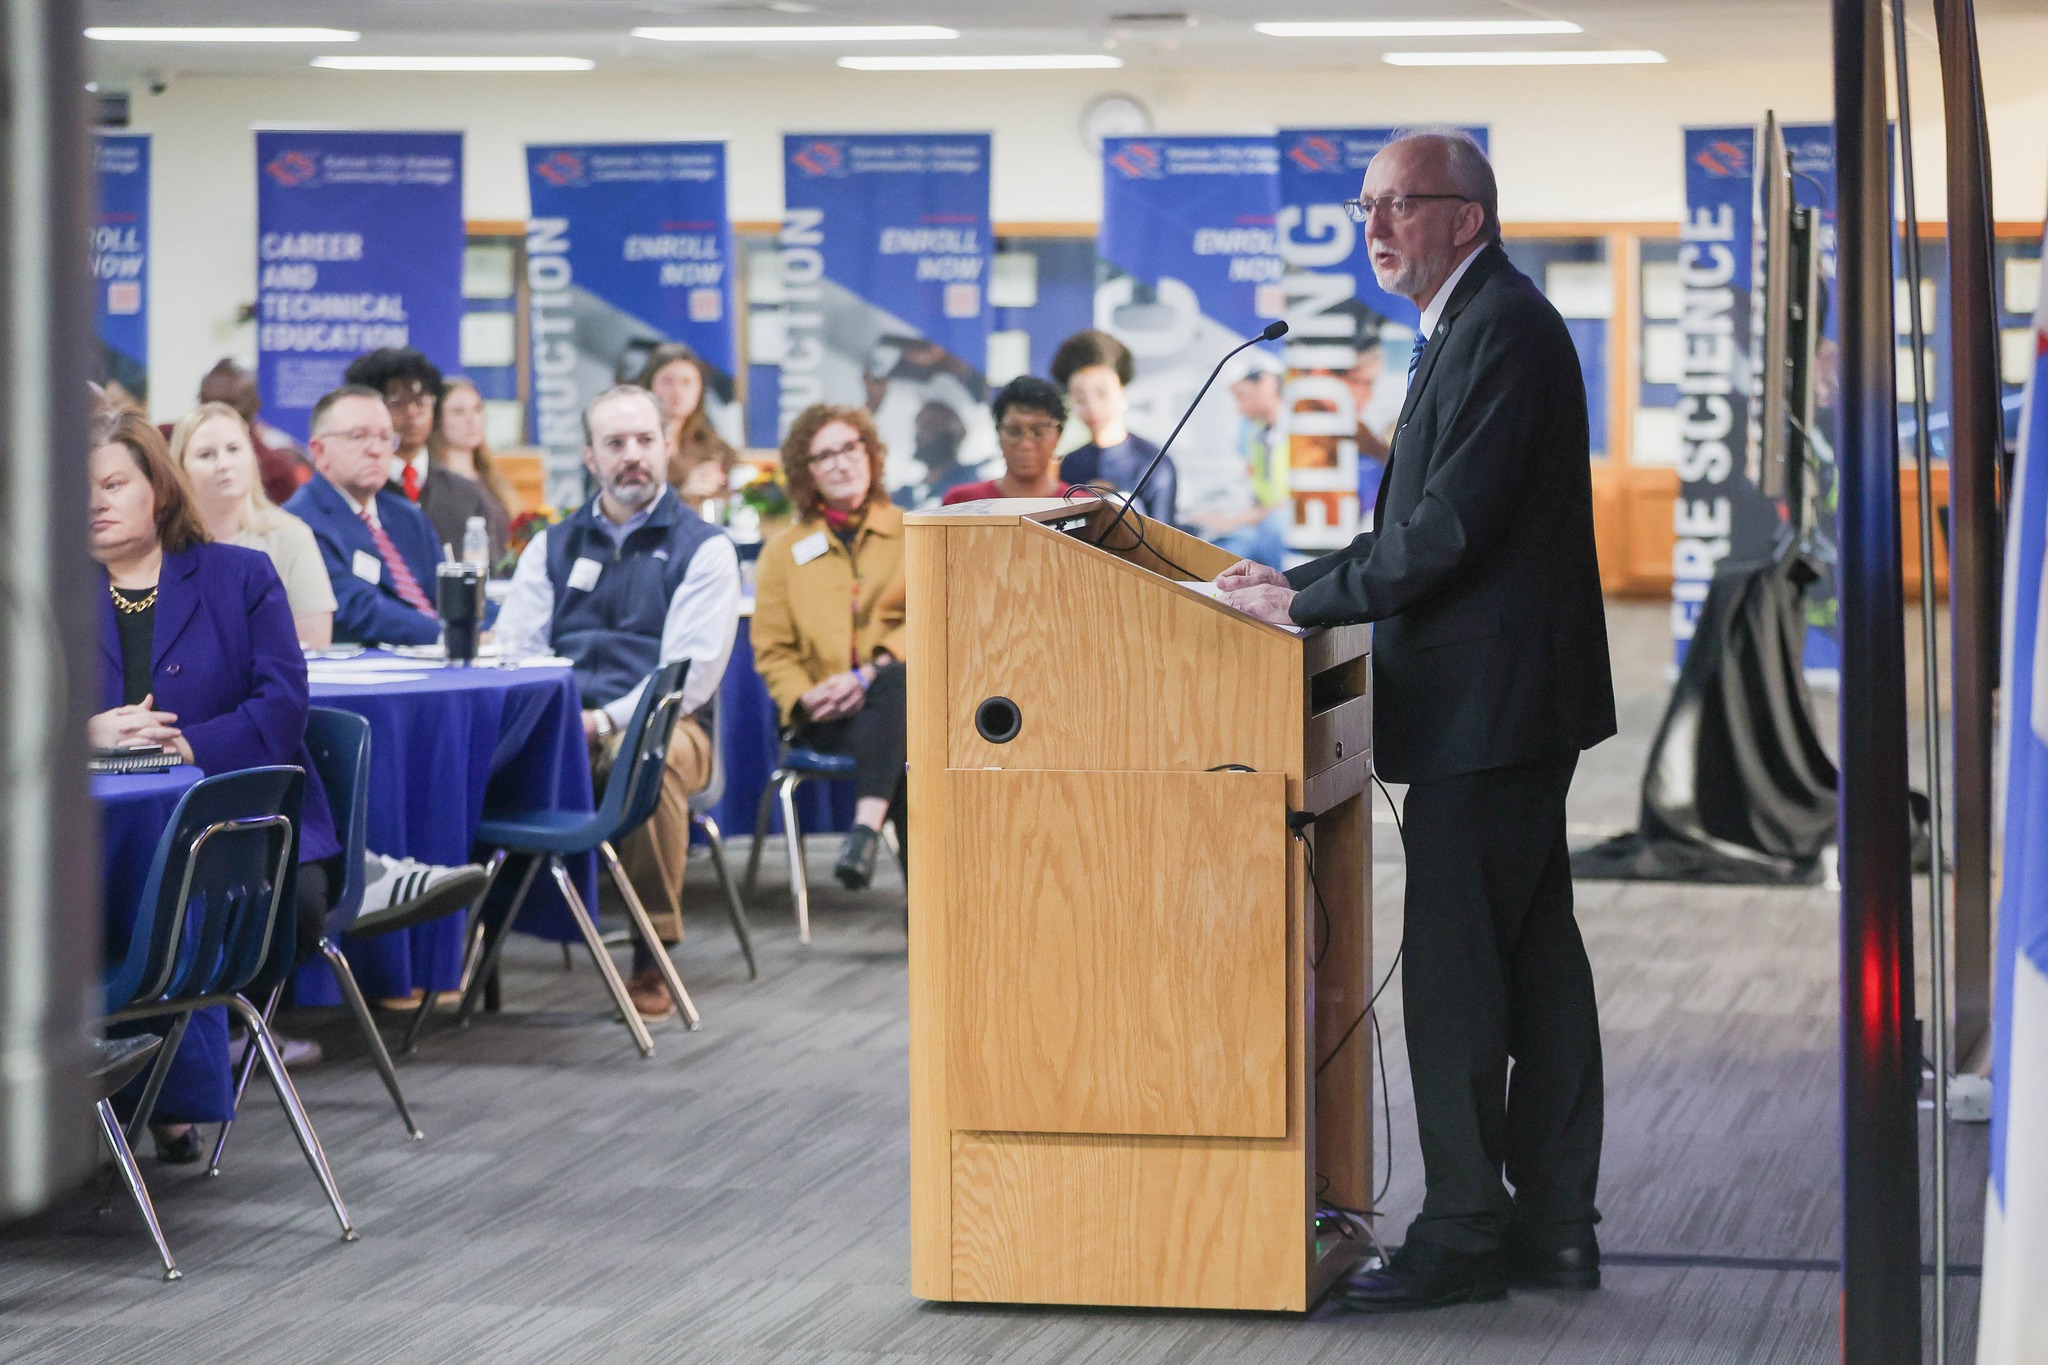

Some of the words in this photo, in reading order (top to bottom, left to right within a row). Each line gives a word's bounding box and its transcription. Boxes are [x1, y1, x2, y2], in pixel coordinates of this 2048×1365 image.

[90, 226, 140, 251] OLL
[262, 233, 363, 261] CAREER
[623, 234, 720, 261] ENROLL
[879, 227, 979, 255] ENROLL
[1193, 227, 1278, 255] ENROL
[262, 263, 318, 291] AND
[660, 262, 724, 287] NOW
[917, 256, 984, 282] NOW
[262, 292, 409, 322] TECHNICAL
[777, 208, 825, 432] UCTION
[261, 323, 410, 352] EDUCATION
[1677, 203, 1736, 484] SCIENCE
[524, 217, 586, 508] STRUCTION
[1278, 203, 1358, 562] ELDING
[1671, 496, 1732, 640] FIRE
